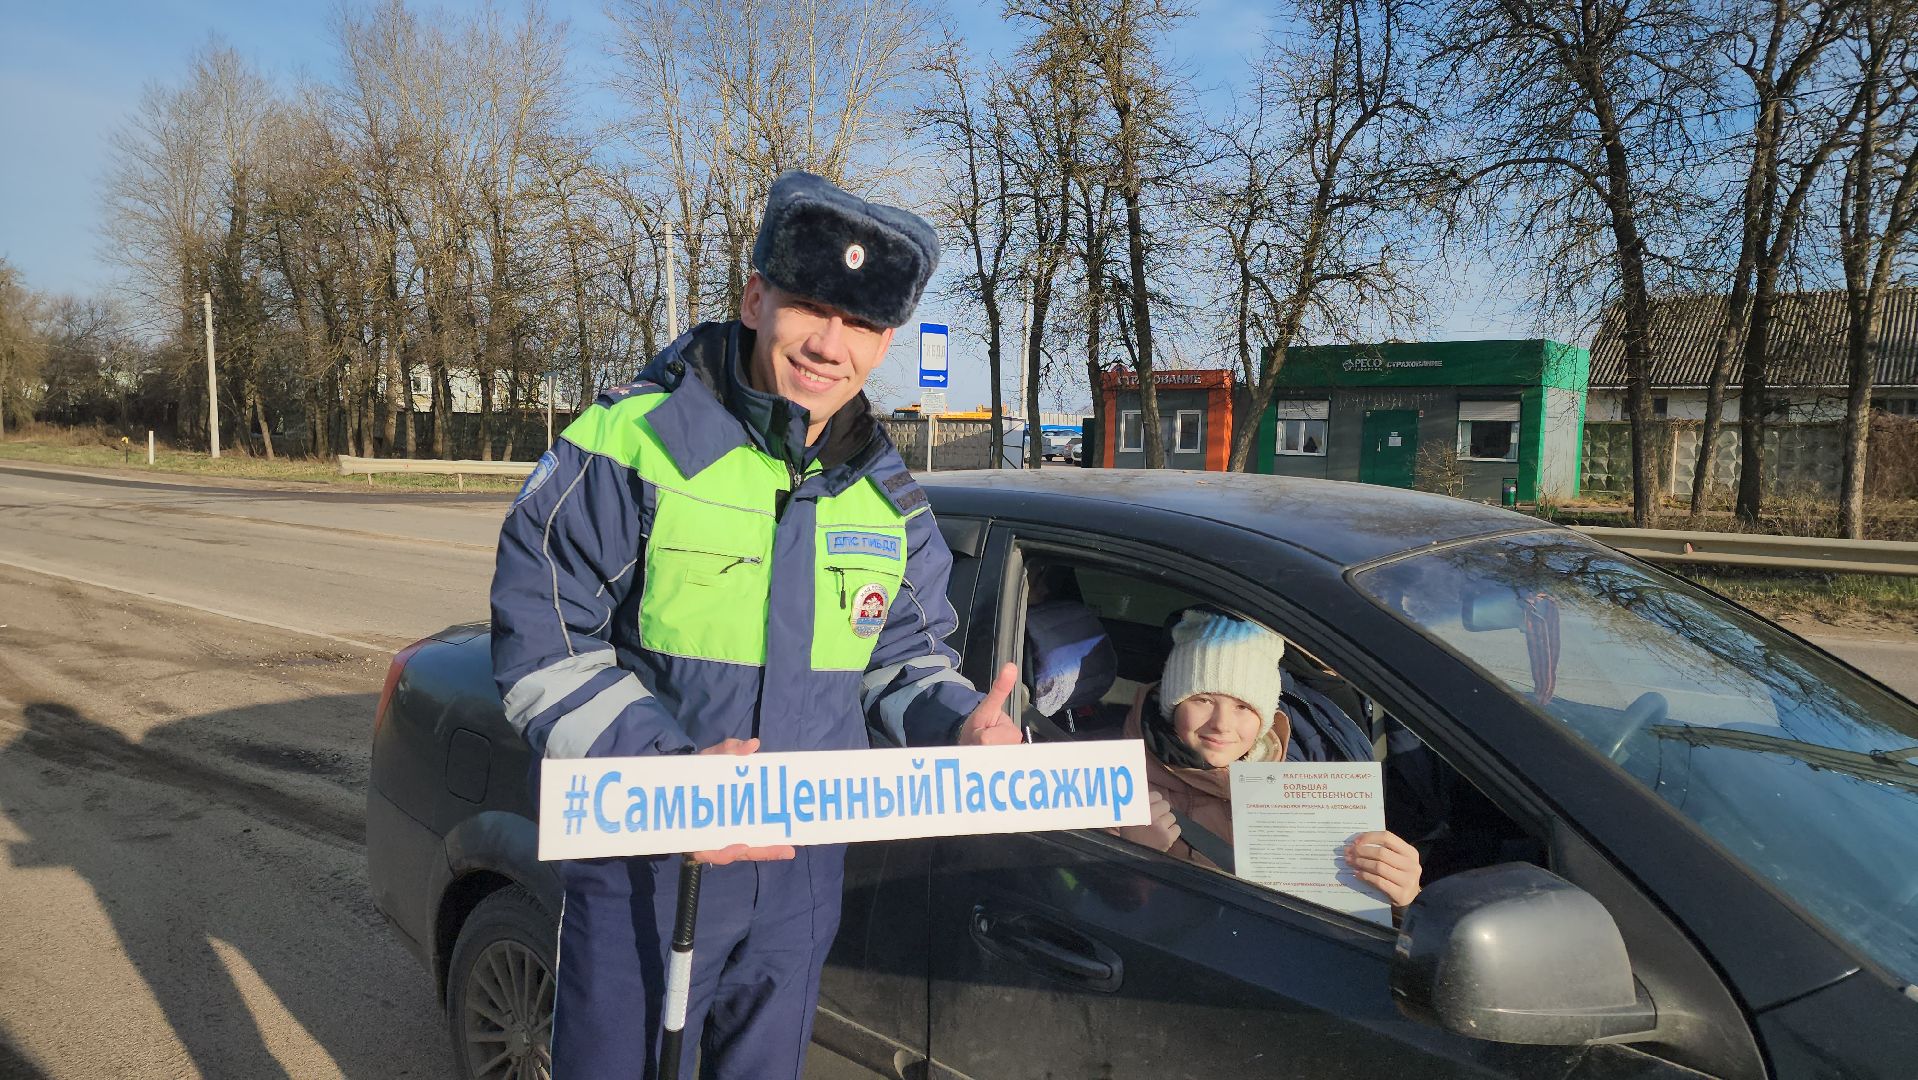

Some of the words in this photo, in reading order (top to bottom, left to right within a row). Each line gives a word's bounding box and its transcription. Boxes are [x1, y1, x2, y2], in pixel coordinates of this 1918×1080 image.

[922, 343, 946, 359] ИБДД
[1117, 374, 1202, 385] СТРОВАНИЕ
[834, 536, 859, 548] ДПС
[862, 537, 897, 554] ГИБДД
[1283, 783, 1328, 791] БОЛЬШАЯ
[563, 758, 1133, 837] #СамыйЦенныйПассажир
[1283, 791, 1373, 799] ОТВЕТСТВЕННОСТЬ!
